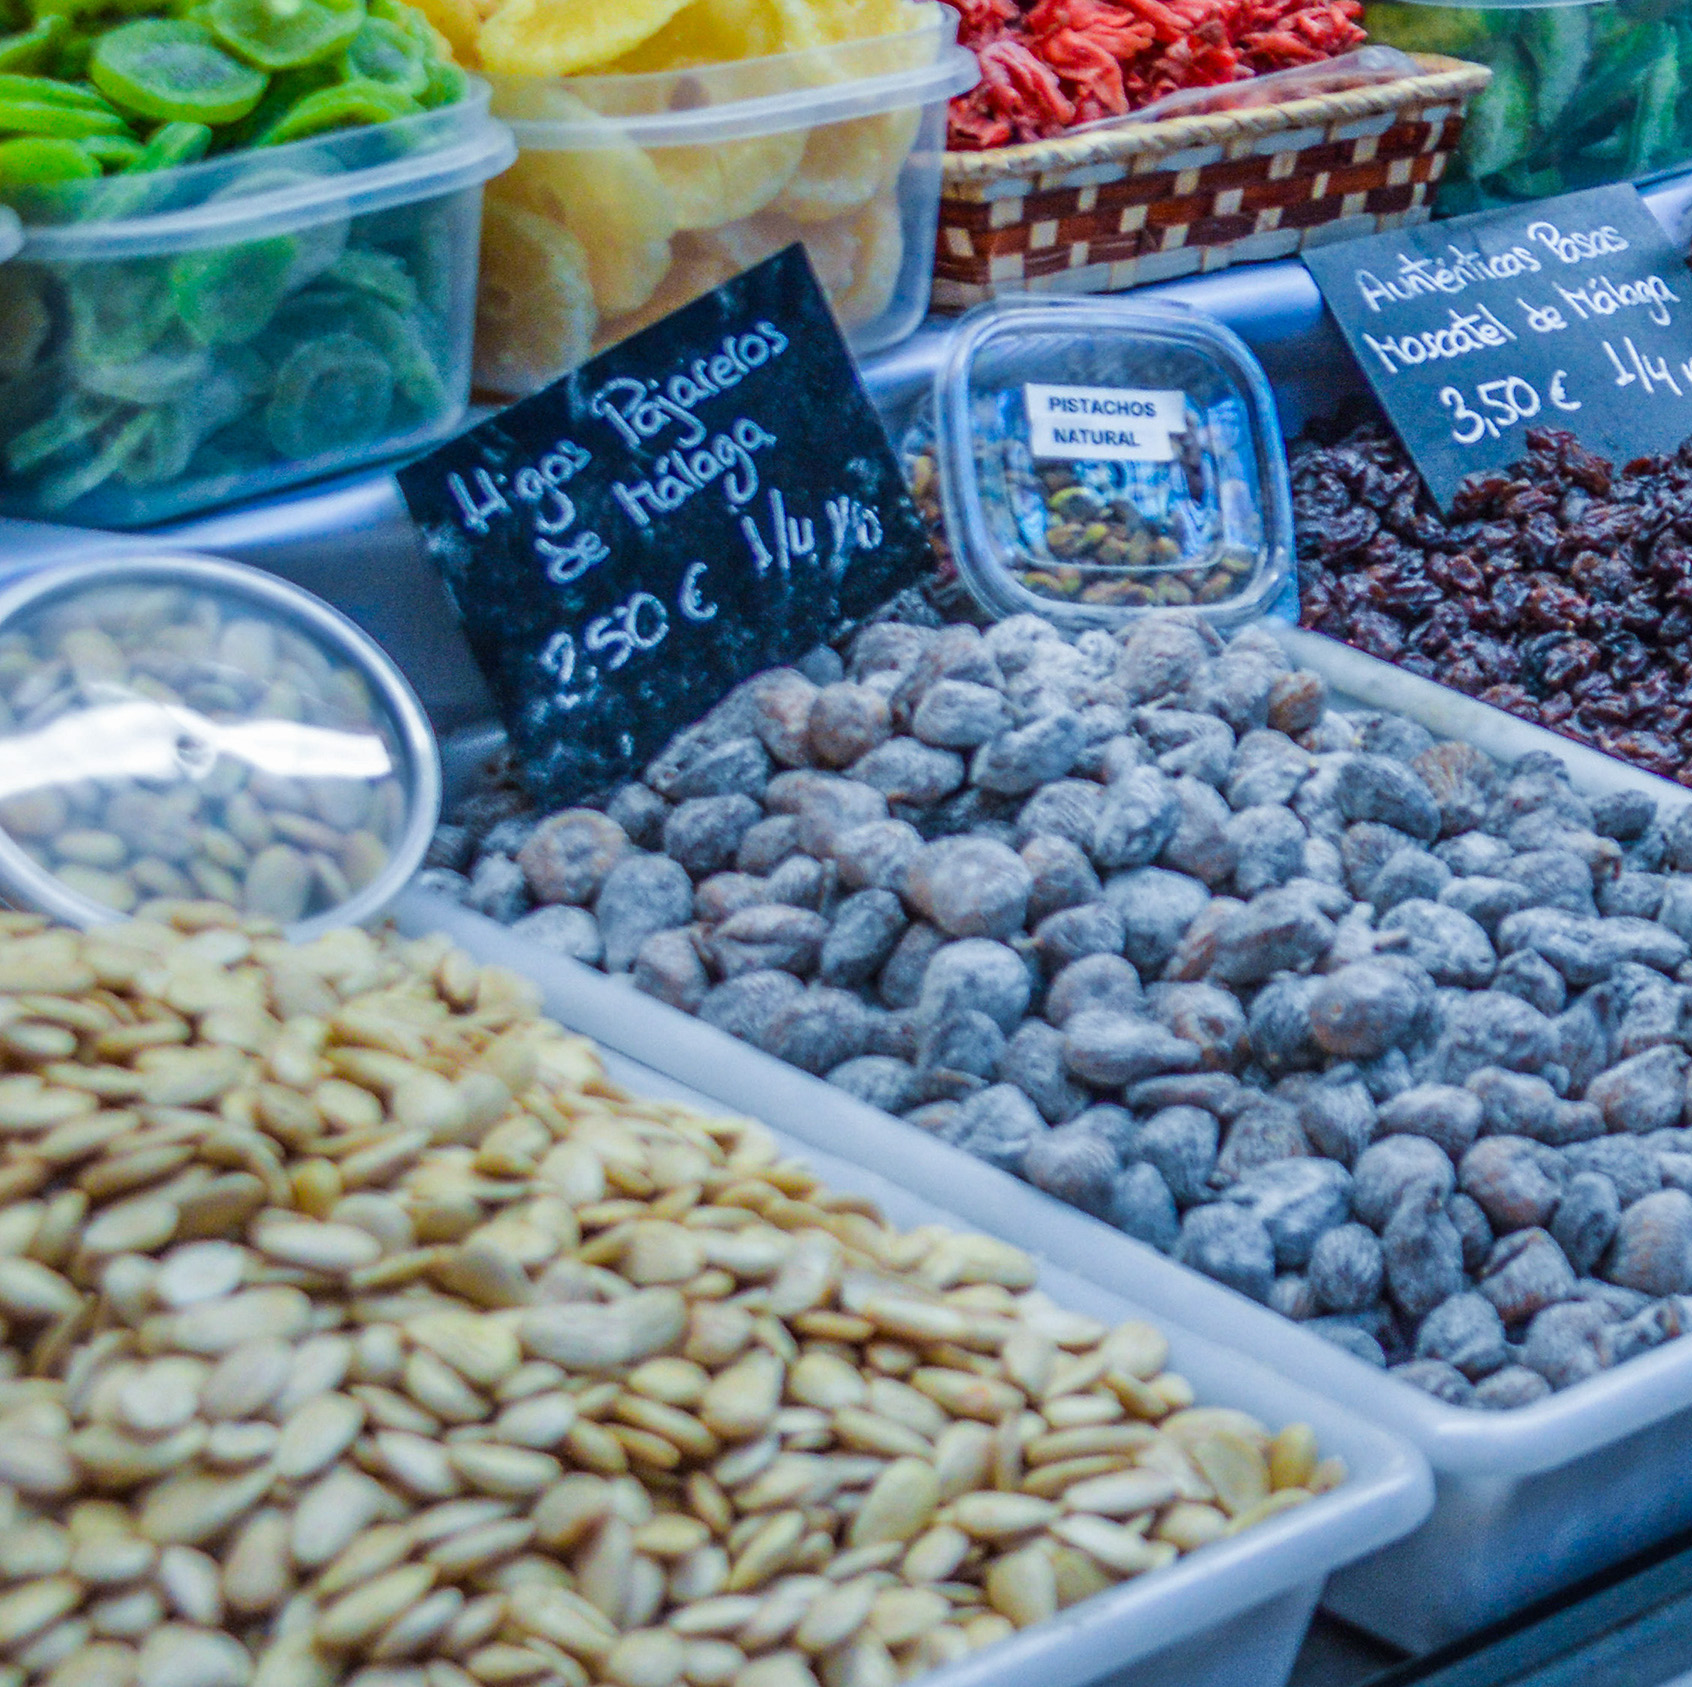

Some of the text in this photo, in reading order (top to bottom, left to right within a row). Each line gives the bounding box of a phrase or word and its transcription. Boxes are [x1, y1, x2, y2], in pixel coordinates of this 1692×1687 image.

[1528, 221, 1630, 264] Pasas
[1363, 275, 1681, 374] Moscatel de Málaga
[448, 320, 790, 534] Higos Pajareros
[1049, 396, 1157, 418] PISTACHOS
[1440, 375, 1541, 444] 3,50
[1549, 369, 1582, 412] €
[1603, 335, 1683, 397] 1/4
[1053, 427, 1141, 447] NATURAL
[534, 417, 777, 584] de Málaga
[680, 562, 718, 621] €
